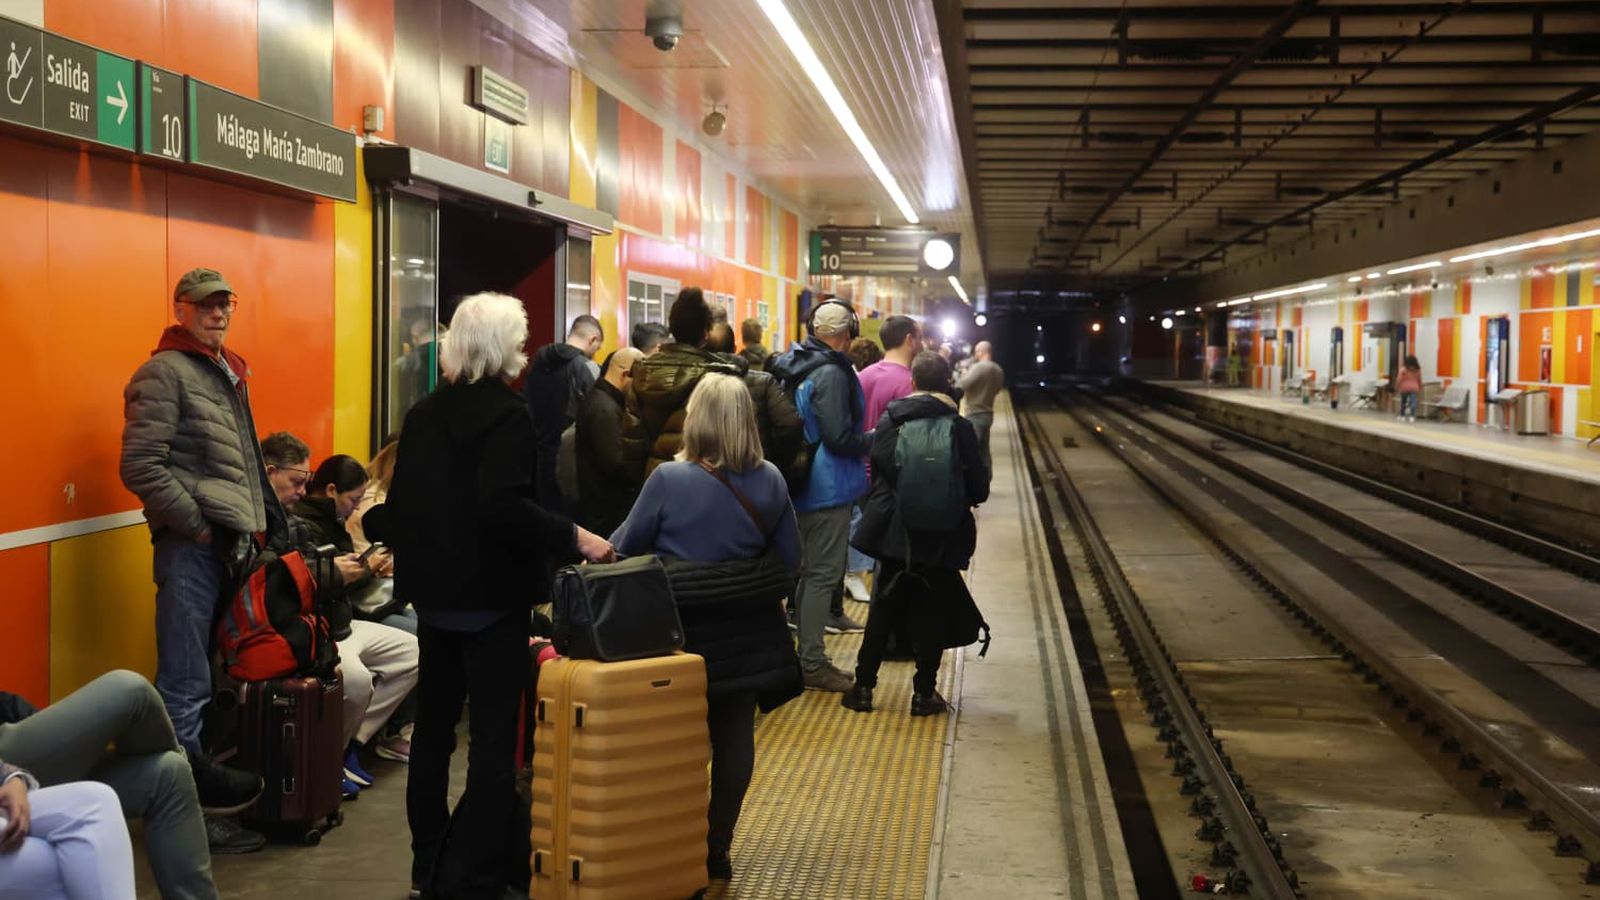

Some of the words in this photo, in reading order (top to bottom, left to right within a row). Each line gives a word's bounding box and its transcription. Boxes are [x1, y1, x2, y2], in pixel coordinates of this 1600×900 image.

[47, 54, 90, 93] Salida
[69, 101, 90, 122] EXIT
[162, 114, 182, 158] 10
[217, 112, 260, 159] Málaga
[263, 127, 293, 162] María
[296, 137, 344, 176] Zambrano
[820, 254, 840, 270] 10
